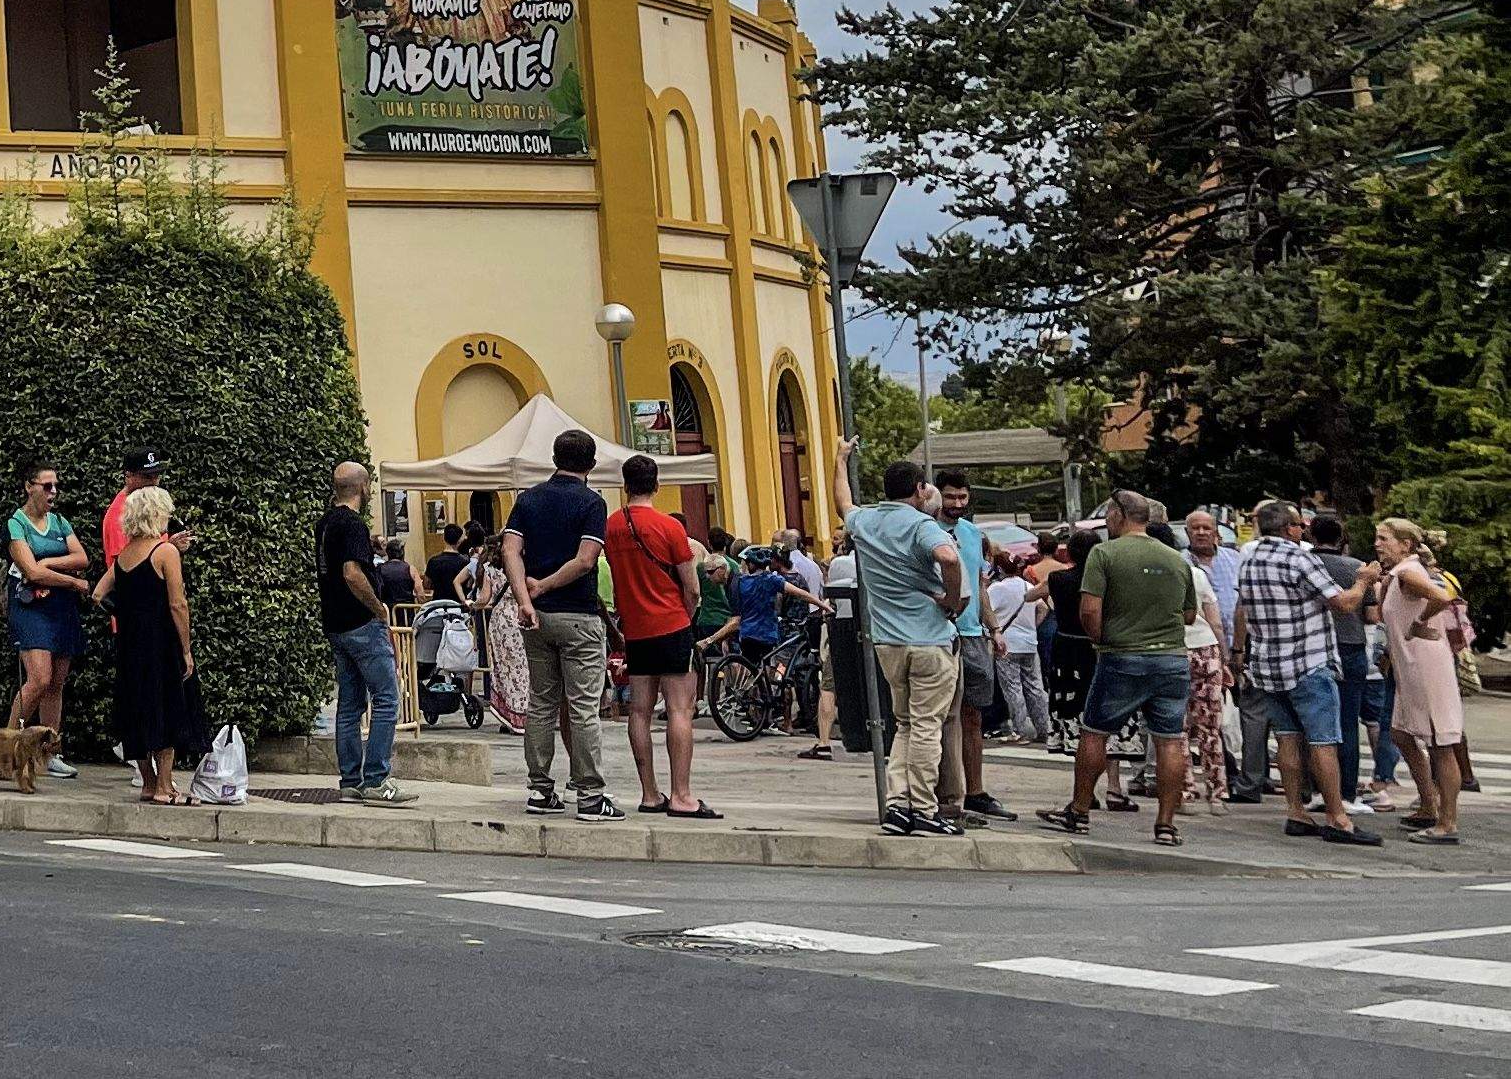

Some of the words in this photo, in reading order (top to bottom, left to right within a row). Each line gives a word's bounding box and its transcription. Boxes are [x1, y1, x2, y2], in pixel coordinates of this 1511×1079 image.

[513, 1, 571, 21] CAYETANO
[367, 27, 556, 100] ¡ABÓNATE!
[421, 101, 463, 119] FERIA
[387, 131, 552, 154] WWW.TAUROEMOCION.COM
[462, 340, 503, 360] SOL
